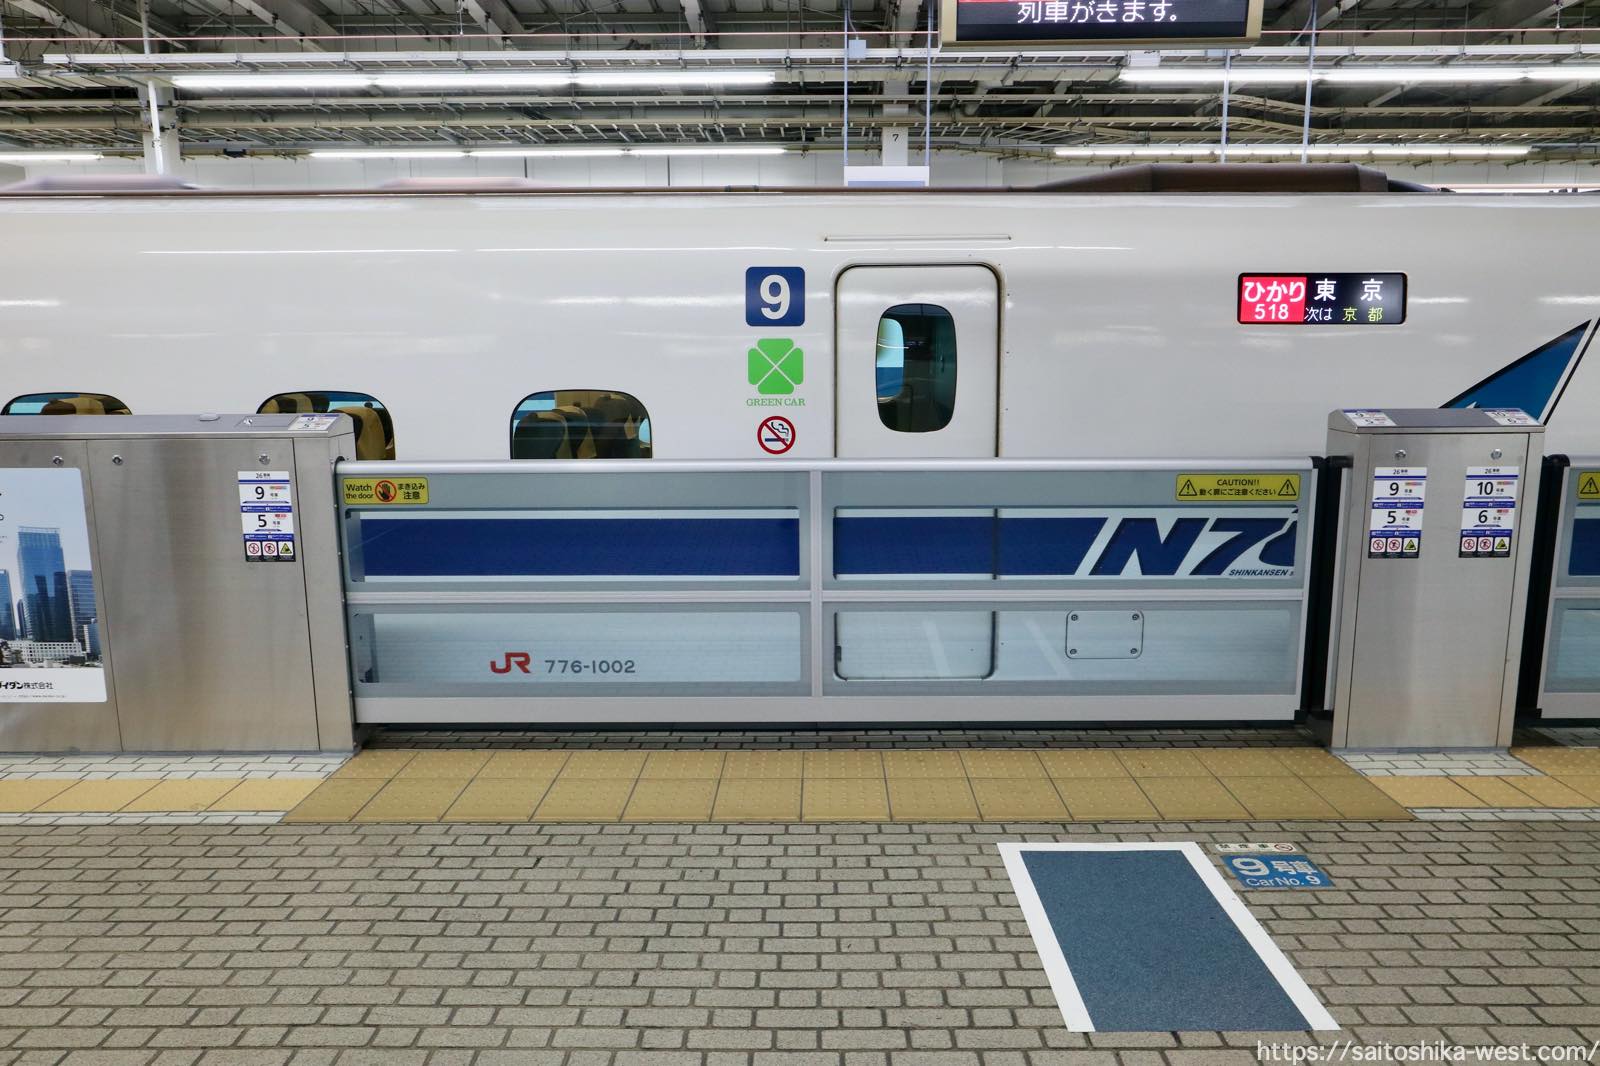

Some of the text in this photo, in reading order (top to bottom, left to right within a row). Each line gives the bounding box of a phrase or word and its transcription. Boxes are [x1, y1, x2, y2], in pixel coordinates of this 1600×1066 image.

[1017, 1, 1178, 23] 列車がきます。
[892, 133, 899, 141] 7
[760, 274, 791, 320] 9
[1244, 281, 1305, 303] ひかり
[1254, 303, 1289, 320] 518
[1304, 306, 1333, 322] 次は
[746, 398, 806, 406] GREEN CAR
[254, 486, 265, 500] 9
[345, 483, 373, 491] Watch
[1389, 482, 1399, 496] 9
[1477, 481, 1494, 495] 10
[403, 491, 420, 500] 注意
[257, 514, 267, 528] 5
[1387, 510, 1397, 524] 5
[1478, 509, 1488, 523] 6
[1229, 569, 1287, 577] SHINKANSEN
[490, 652, 531, 674] JR
[545, 659, 636, 674] 776-1002
[1305, 875, 1321, 885] 9
